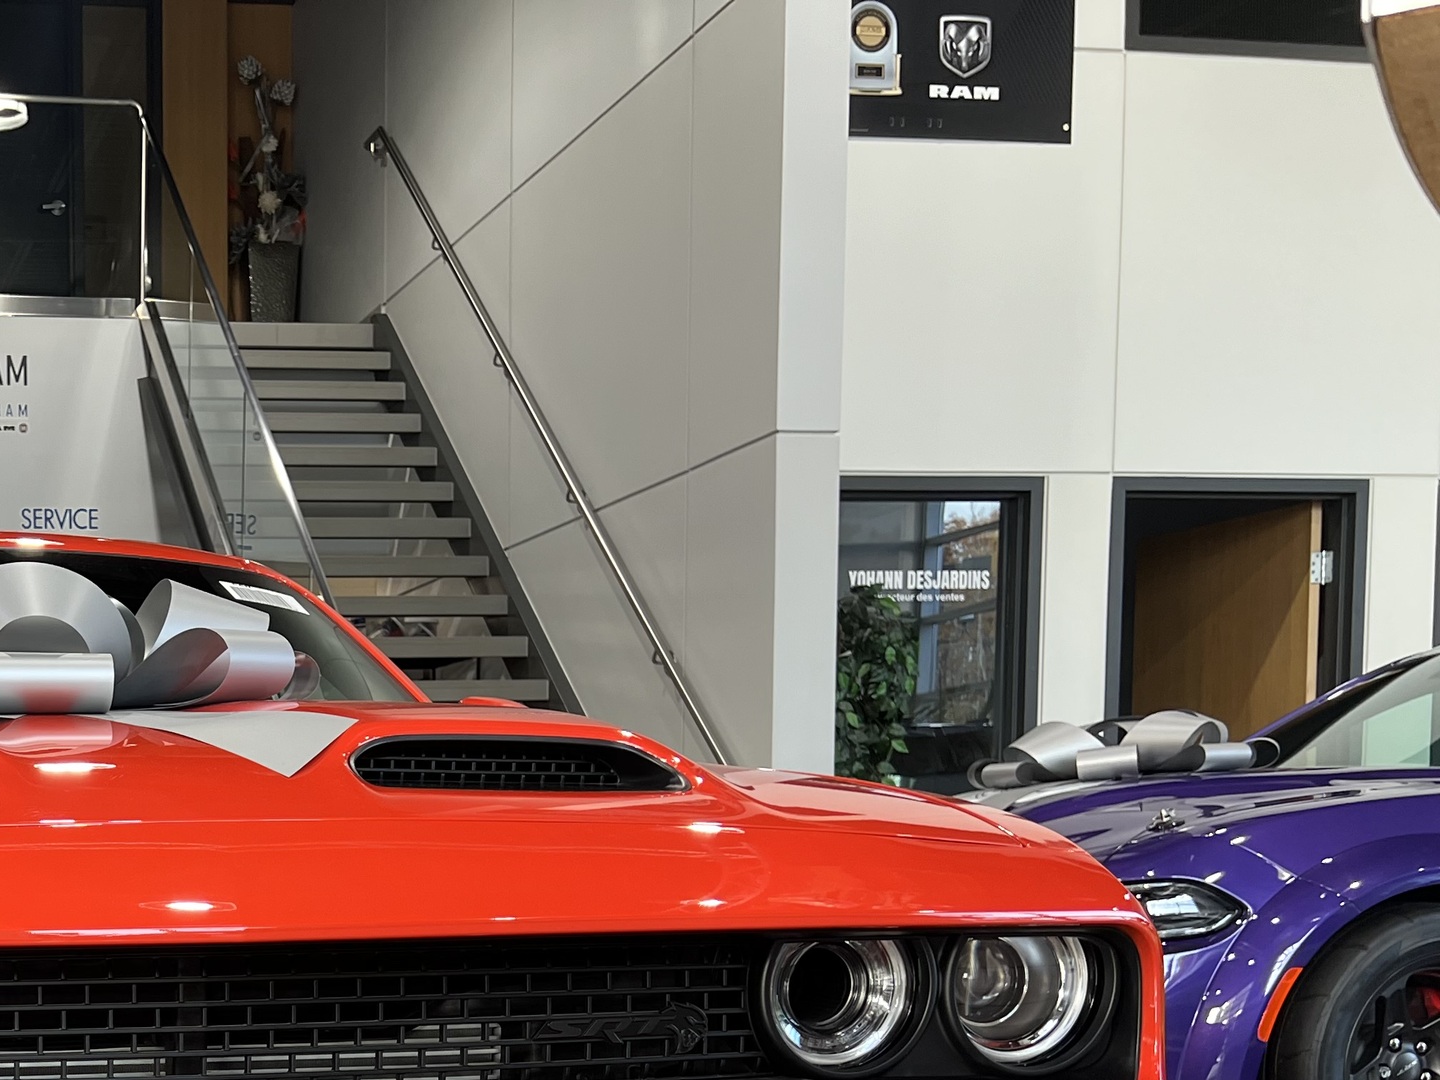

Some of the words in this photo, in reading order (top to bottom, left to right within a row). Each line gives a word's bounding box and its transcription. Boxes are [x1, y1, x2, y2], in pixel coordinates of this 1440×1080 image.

[929, 84, 1000, 100] RAM
[22, 508, 98, 529] SERVICE
[907, 570, 990, 589] DESJARDINS
